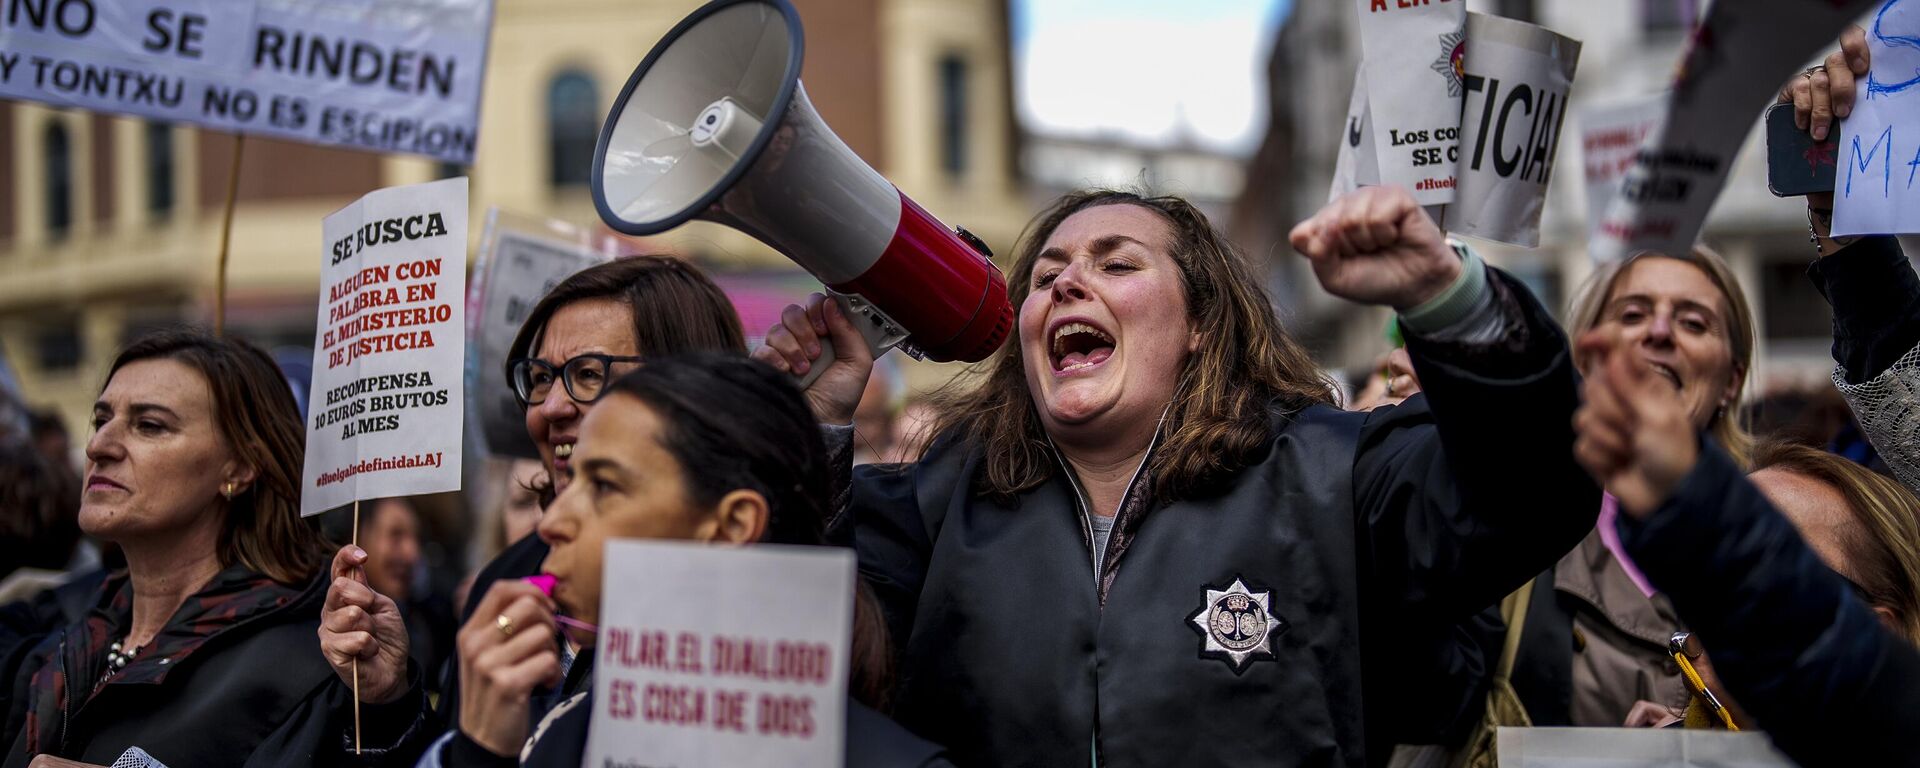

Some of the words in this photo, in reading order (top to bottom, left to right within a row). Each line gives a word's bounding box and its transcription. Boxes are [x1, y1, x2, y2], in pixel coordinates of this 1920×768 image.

[8, 0, 96, 38] NO
[144, 8, 206, 58] SE
[253, 24, 456, 98] RINDEN
[0, 52, 19, 83] Y
[30, 55, 184, 108] TONTXU
[203, 85, 258, 122] NO
[269, 94, 308, 129] ES
[1390, 129, 1429, 146] Los
[1412, 147, 1443, 167] SE
[332, 233, 354, 267] SE
[356, 212, 448, 253] BUSCA
[329, 265, 390, 304] ALGUIEN
[396, 258, 442, 281] CON
[329, 287, 401, 325] PALABRA
[406, 282, 437, 303] EN
[323, 331, 336, 350] EL
[338, 304, 452, 345] MINISTERIO
[328, 348, 344, 369] DE
[346, 330, 434, 366] JUSTICIA
[315, 412, 326, 430] 10
[327, 398, 366, 426] EUROS
[369, 389, 448, 413] BRUTOS
[326, 371, 433, 406] RECOMPENSA
[342, 420, 356, 440] AL
[357, 415, 400, 434] MES
[609, 678, 637, 721] ES
[643, 682, 707, 727] COSA
[713, 690, 748, 733] DE
[756, 693, 816, 740] DOS
